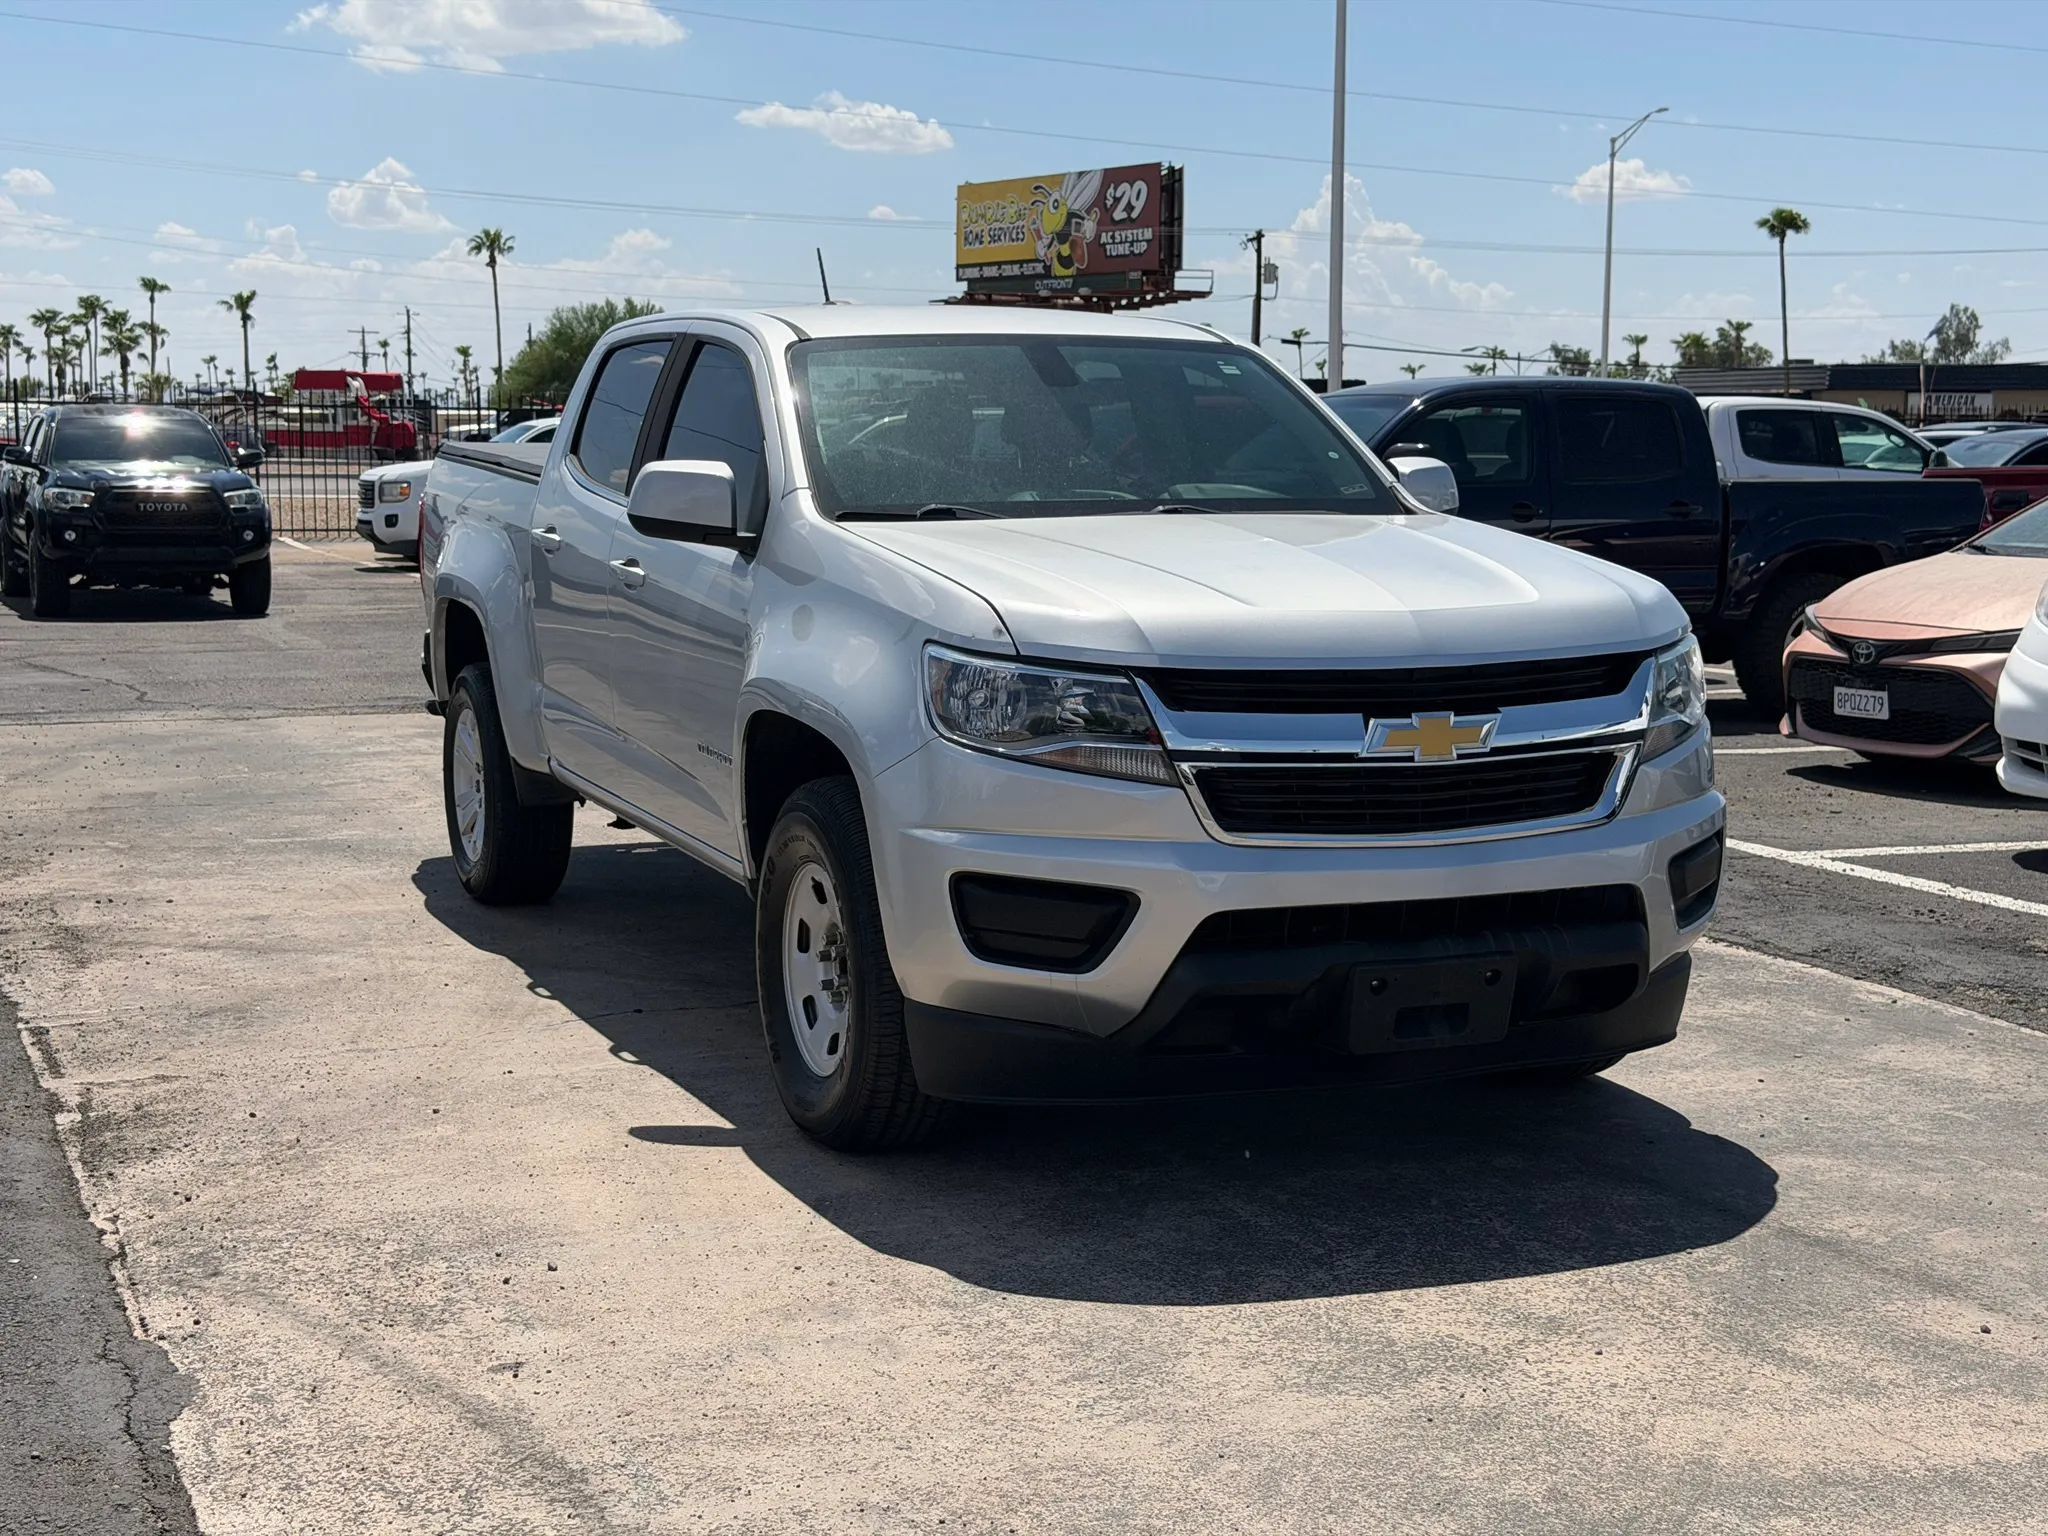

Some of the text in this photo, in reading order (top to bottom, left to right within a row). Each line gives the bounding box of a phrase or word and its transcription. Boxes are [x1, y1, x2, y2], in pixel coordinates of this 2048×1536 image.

[1105, 180, 1148, 221] $29
[964, 224, 1026, 248] HOME SERVICES
[1100, 227, 1153, 244] AC SYSTEM
[1105, 241, 1148, 256] TUNE-UP
[138, 502, 188, 512] TOYOTA
